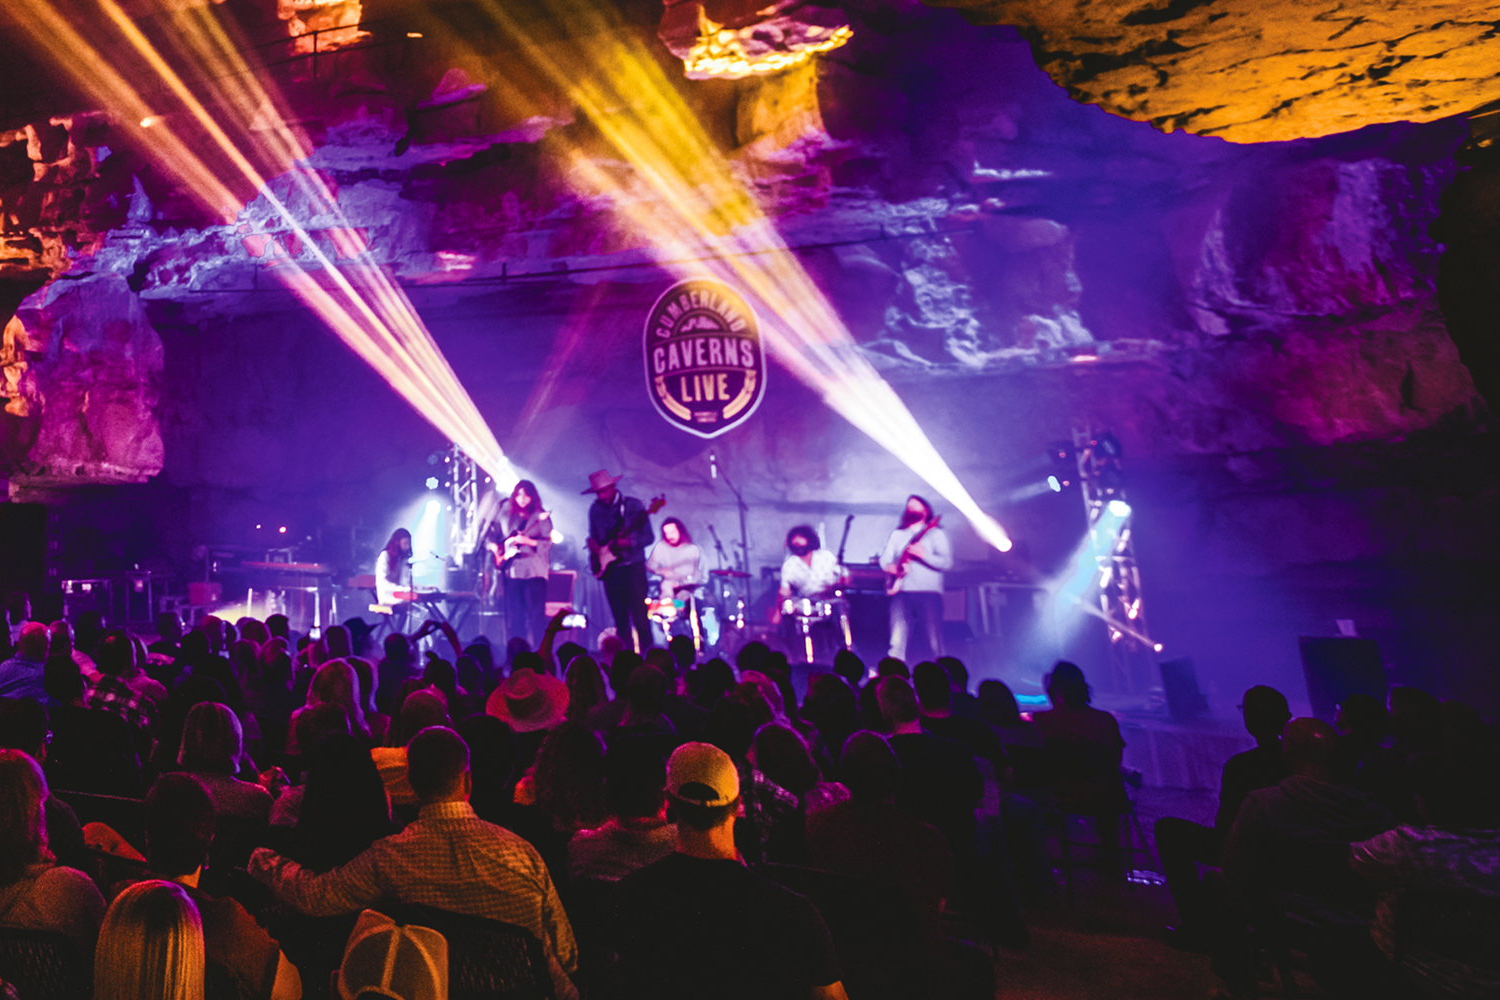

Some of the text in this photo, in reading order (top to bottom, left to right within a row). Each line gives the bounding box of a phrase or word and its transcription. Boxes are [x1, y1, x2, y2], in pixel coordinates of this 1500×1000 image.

[655, 290, 747, 338] CUMBERLAND
[652, 338, 755, 374] CAVERNS
[680, 373, 731, 403] LIVE
